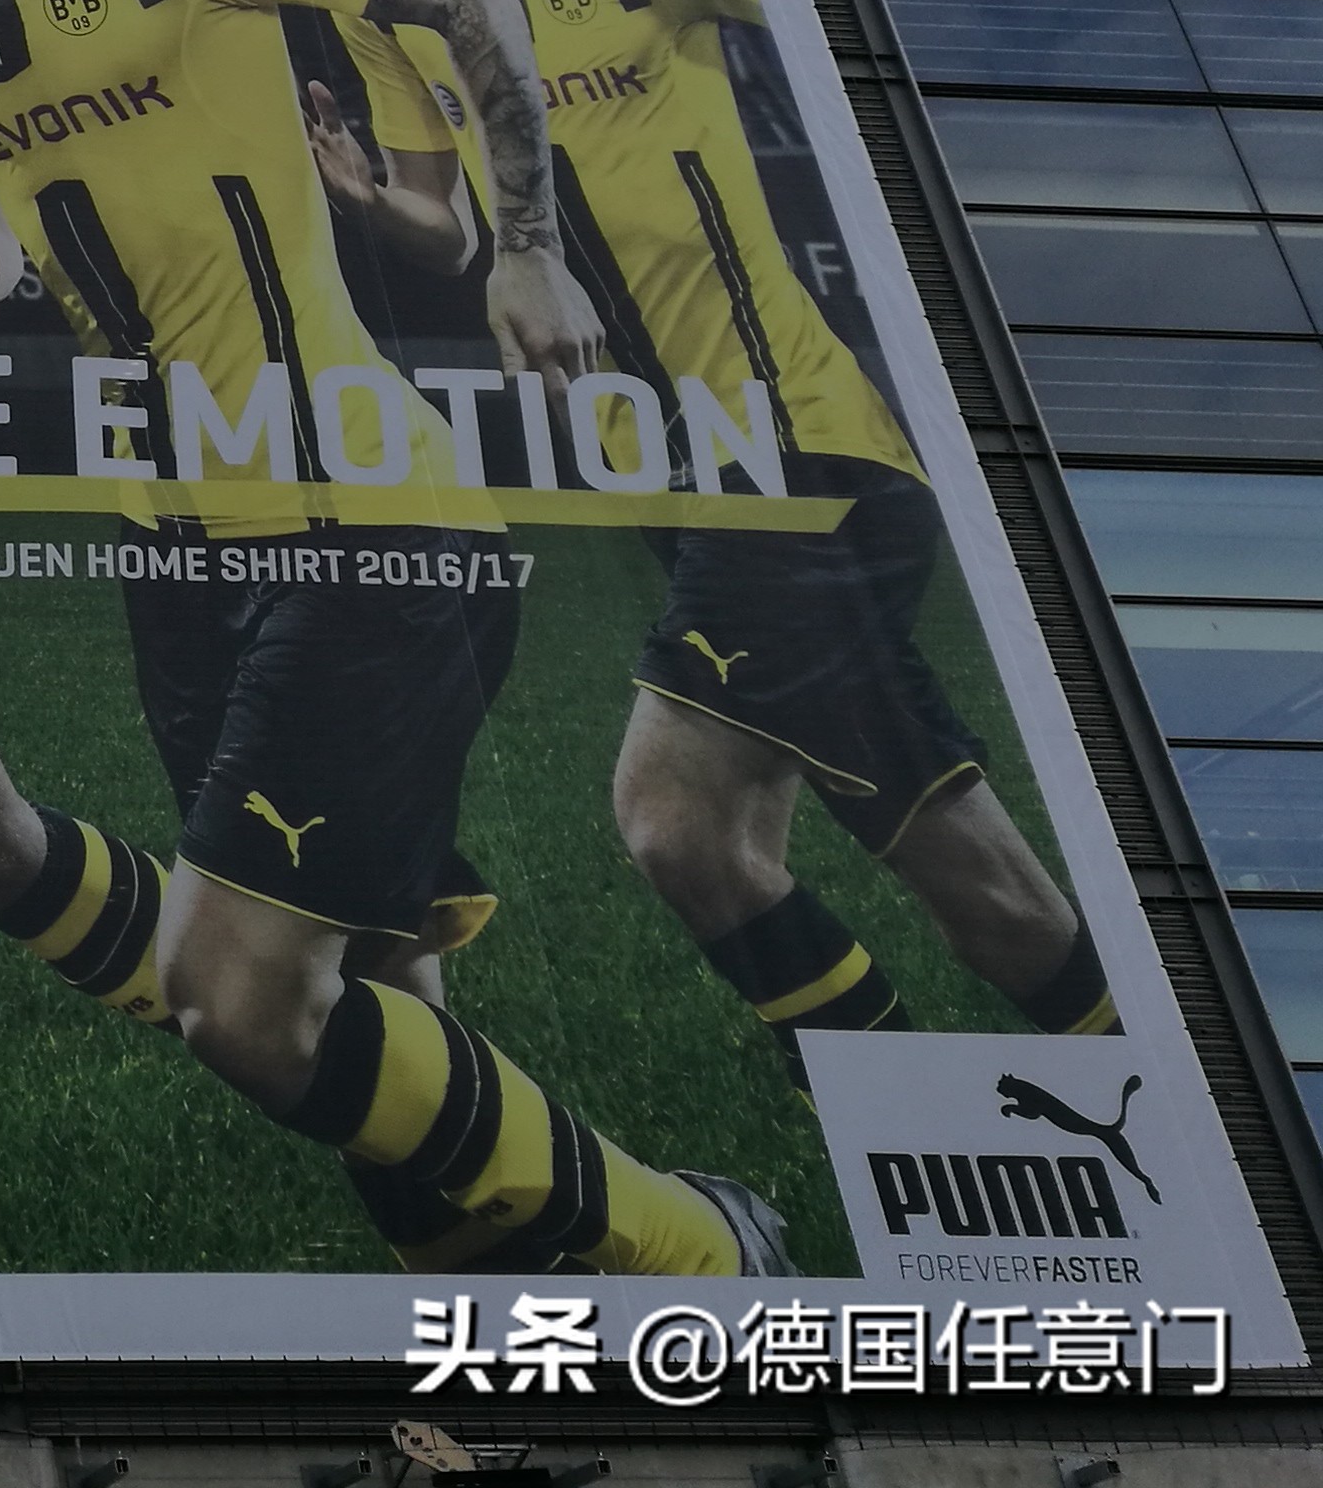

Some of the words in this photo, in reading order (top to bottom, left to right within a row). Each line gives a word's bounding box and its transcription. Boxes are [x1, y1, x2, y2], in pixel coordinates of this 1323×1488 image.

[71, 15, 91, 30] 09
[566, 8, 583, 21] 09
[70, 356, 789, 498] EMOTION
[87, 543, 208, 583] HOME
[219, 546, 344, 585] SHIRT
[356, 550, 535, 595] 2016/17
[866, 1152, 1130, 1238] PUMA
